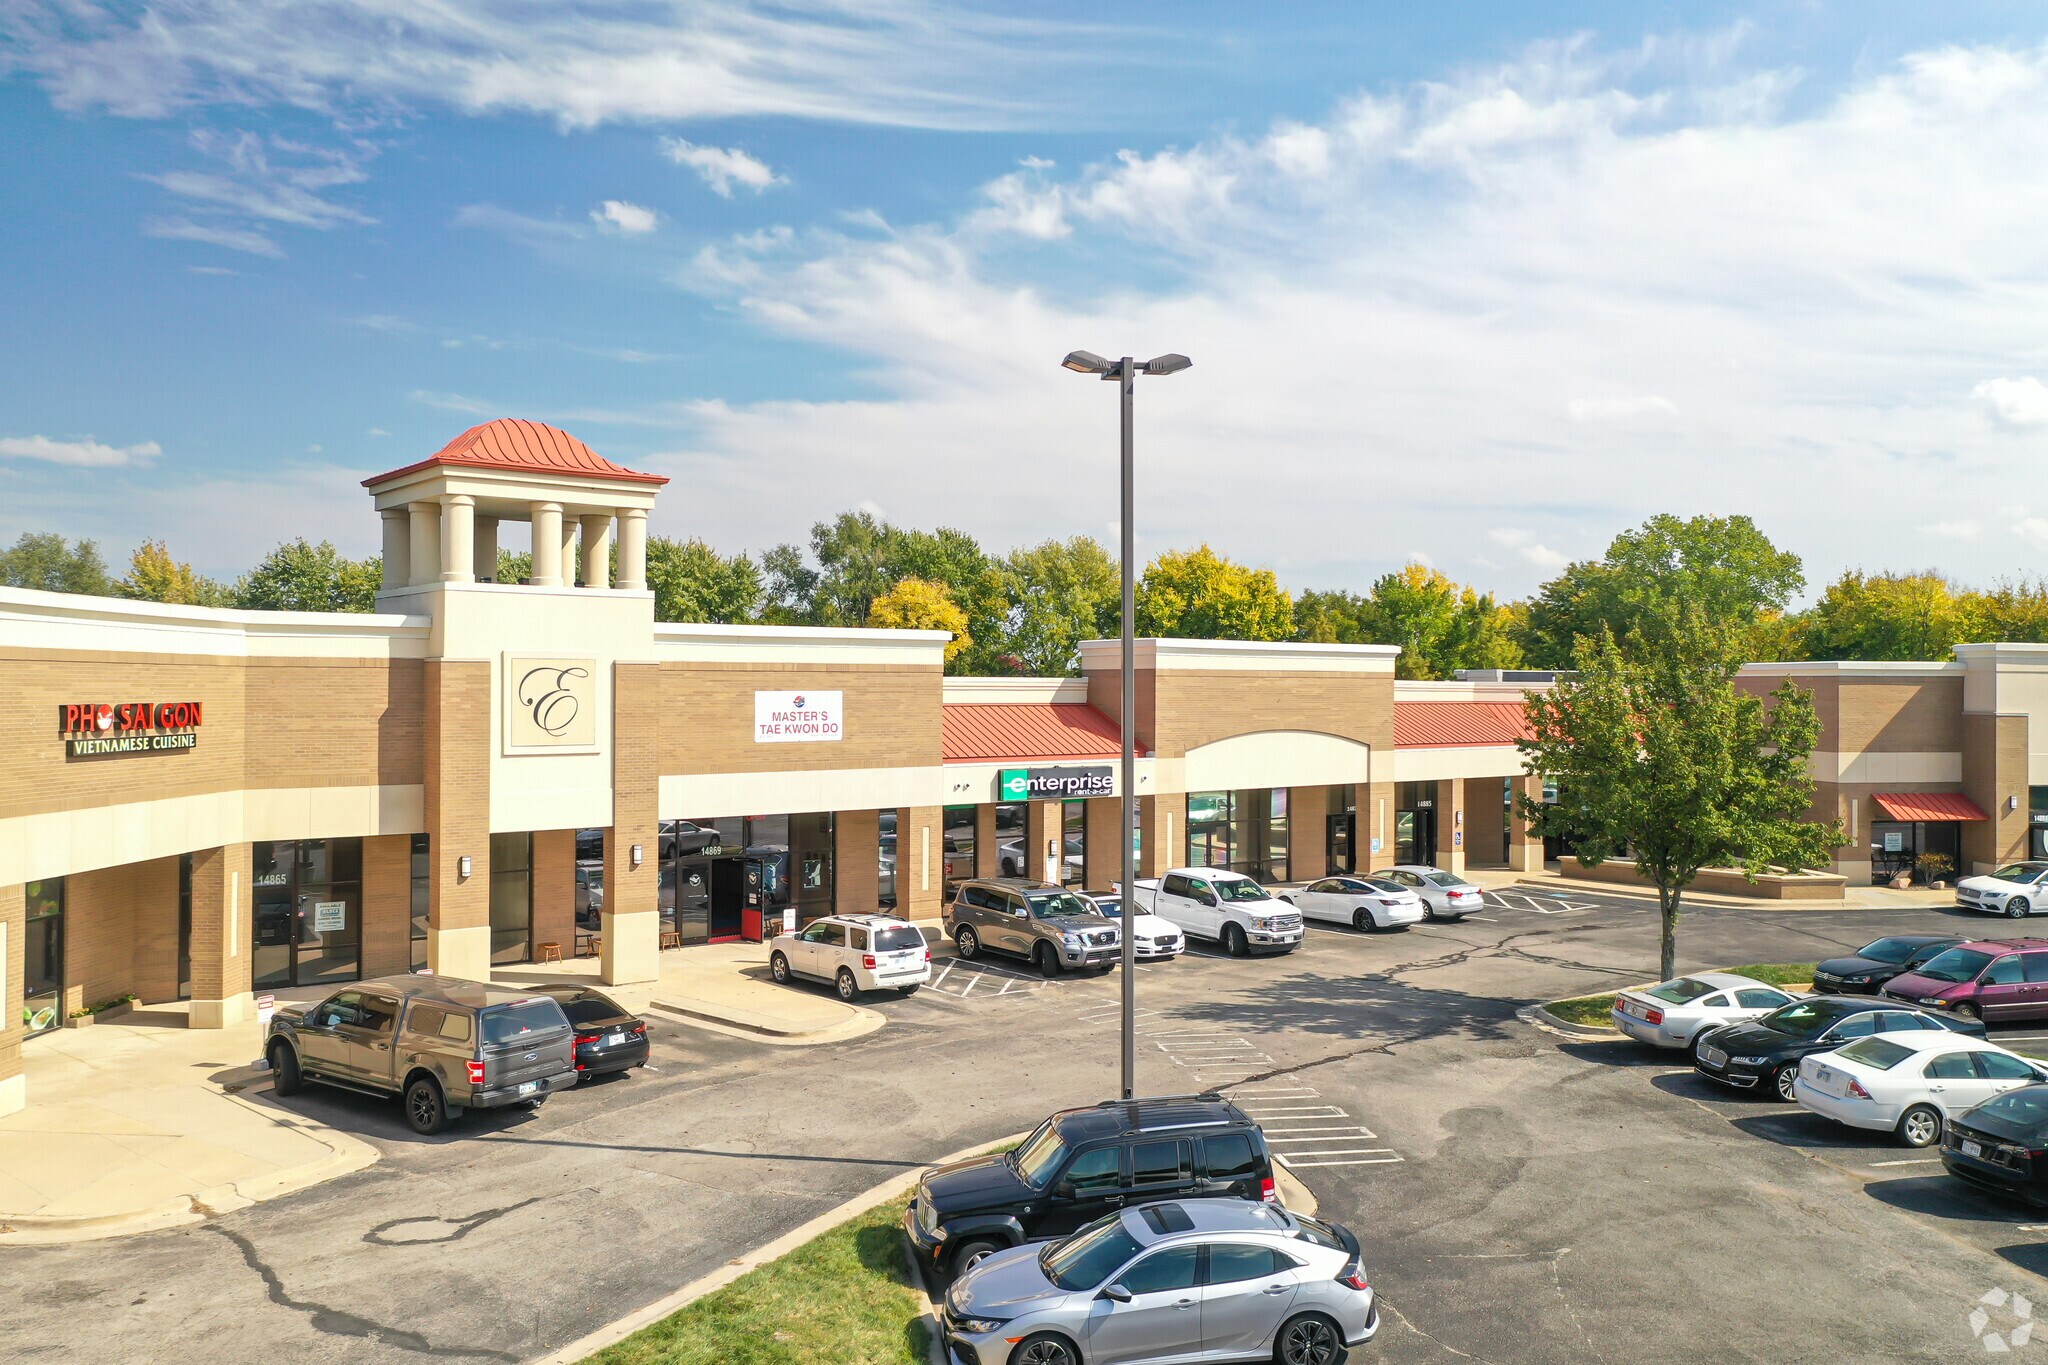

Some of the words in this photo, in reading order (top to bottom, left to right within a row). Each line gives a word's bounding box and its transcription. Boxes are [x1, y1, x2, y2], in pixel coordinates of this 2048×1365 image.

[518, 667, 589, 738] E
[772, 711, 828, 722] MASTER'S
[760, 724, 781, 735] TAE
[784, 723, 819, 734] KWON
[822, 723, 839, 733] DO
[75, 737, 150, 755] VIETNAMESE
[152, 734, 195, 750] CUISINE
[1004, 772, 1114, 794] enterprise
[1074, 788, 1111, 796] rent-a-car
[701, 845, 722, 856] 14869
[258, 873, 287, 886] 14865
